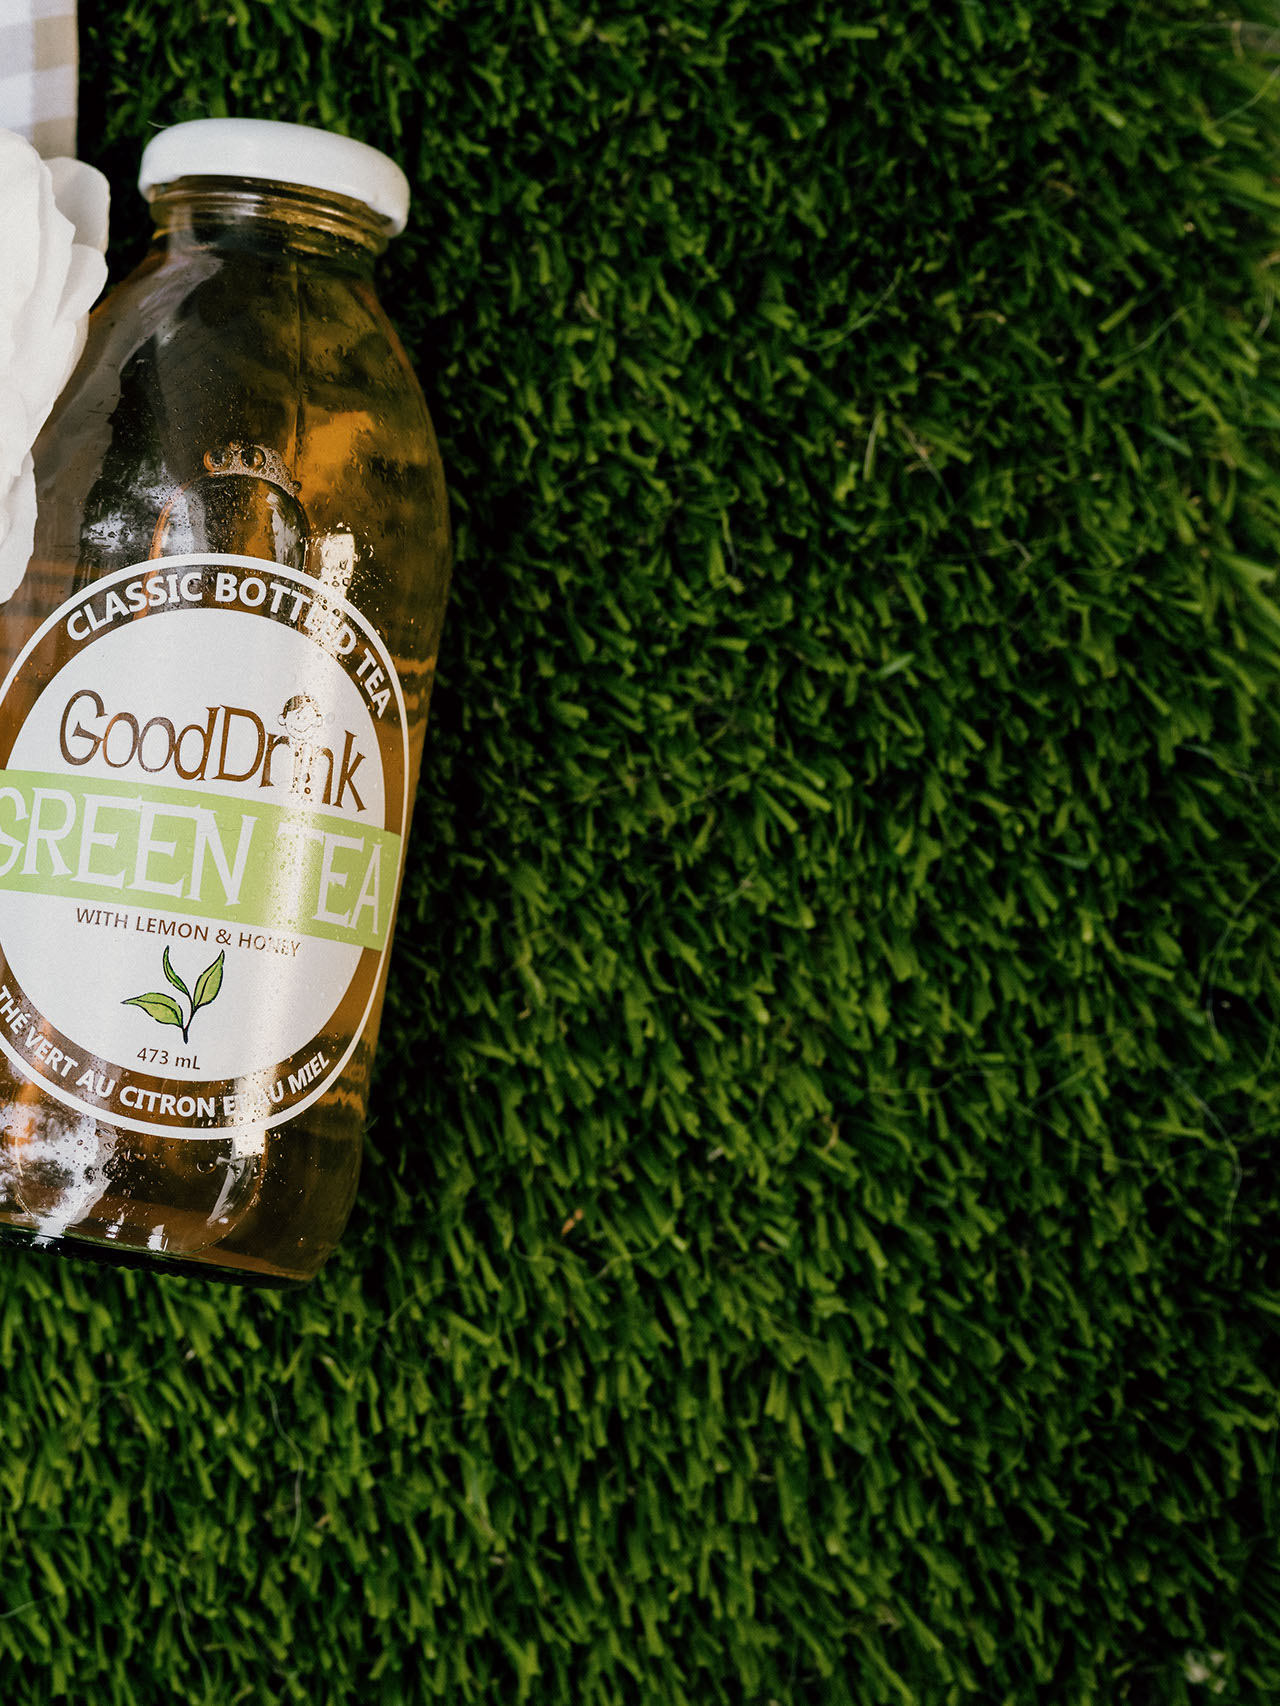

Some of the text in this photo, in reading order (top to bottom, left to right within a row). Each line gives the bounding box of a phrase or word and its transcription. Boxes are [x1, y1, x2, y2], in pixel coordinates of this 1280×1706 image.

[66, 571, 203, 642] CLASSIC
[356, 647, 392, 719] TEA
[276, 822, 384, 936] TEA
[76, 906, 129, 930] WITH
[135, 915, 209, 942] LEMON
[215, 928, 233, 946] &
[25, 1029, 79, 1078] VERT
[75, 1066, 114, 1100] AU
[119, 1085, 216, 1119] CITRON
[223, 1092, 247, 1117] E
[288, 1051, 331, 1096] MIEL
[136, 1047, 202, 1071] 473 mL
